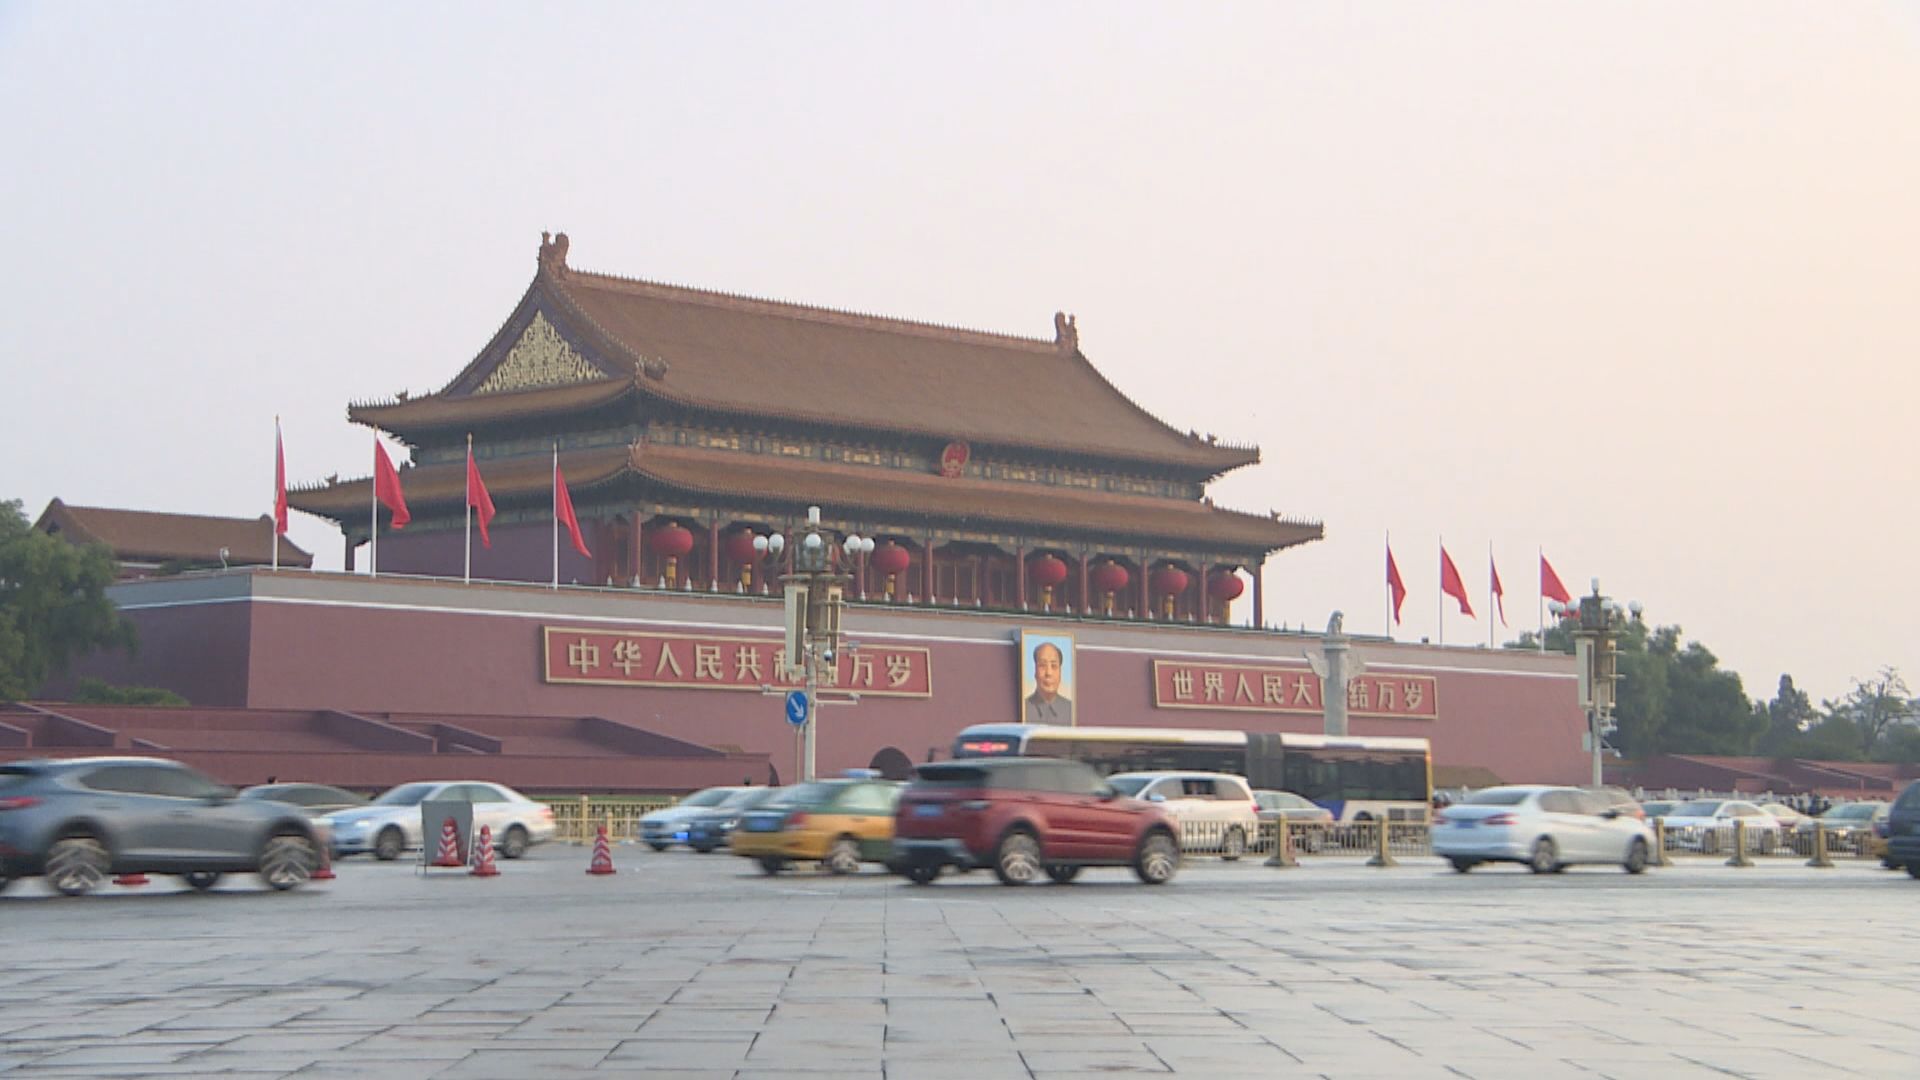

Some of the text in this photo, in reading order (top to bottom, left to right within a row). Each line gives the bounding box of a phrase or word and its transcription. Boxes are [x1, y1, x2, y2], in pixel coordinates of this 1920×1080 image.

[568, 638, 913, 688] 中华人民共和万岁
[1172, 669, 1424, 711] 世界人民大结万岁
